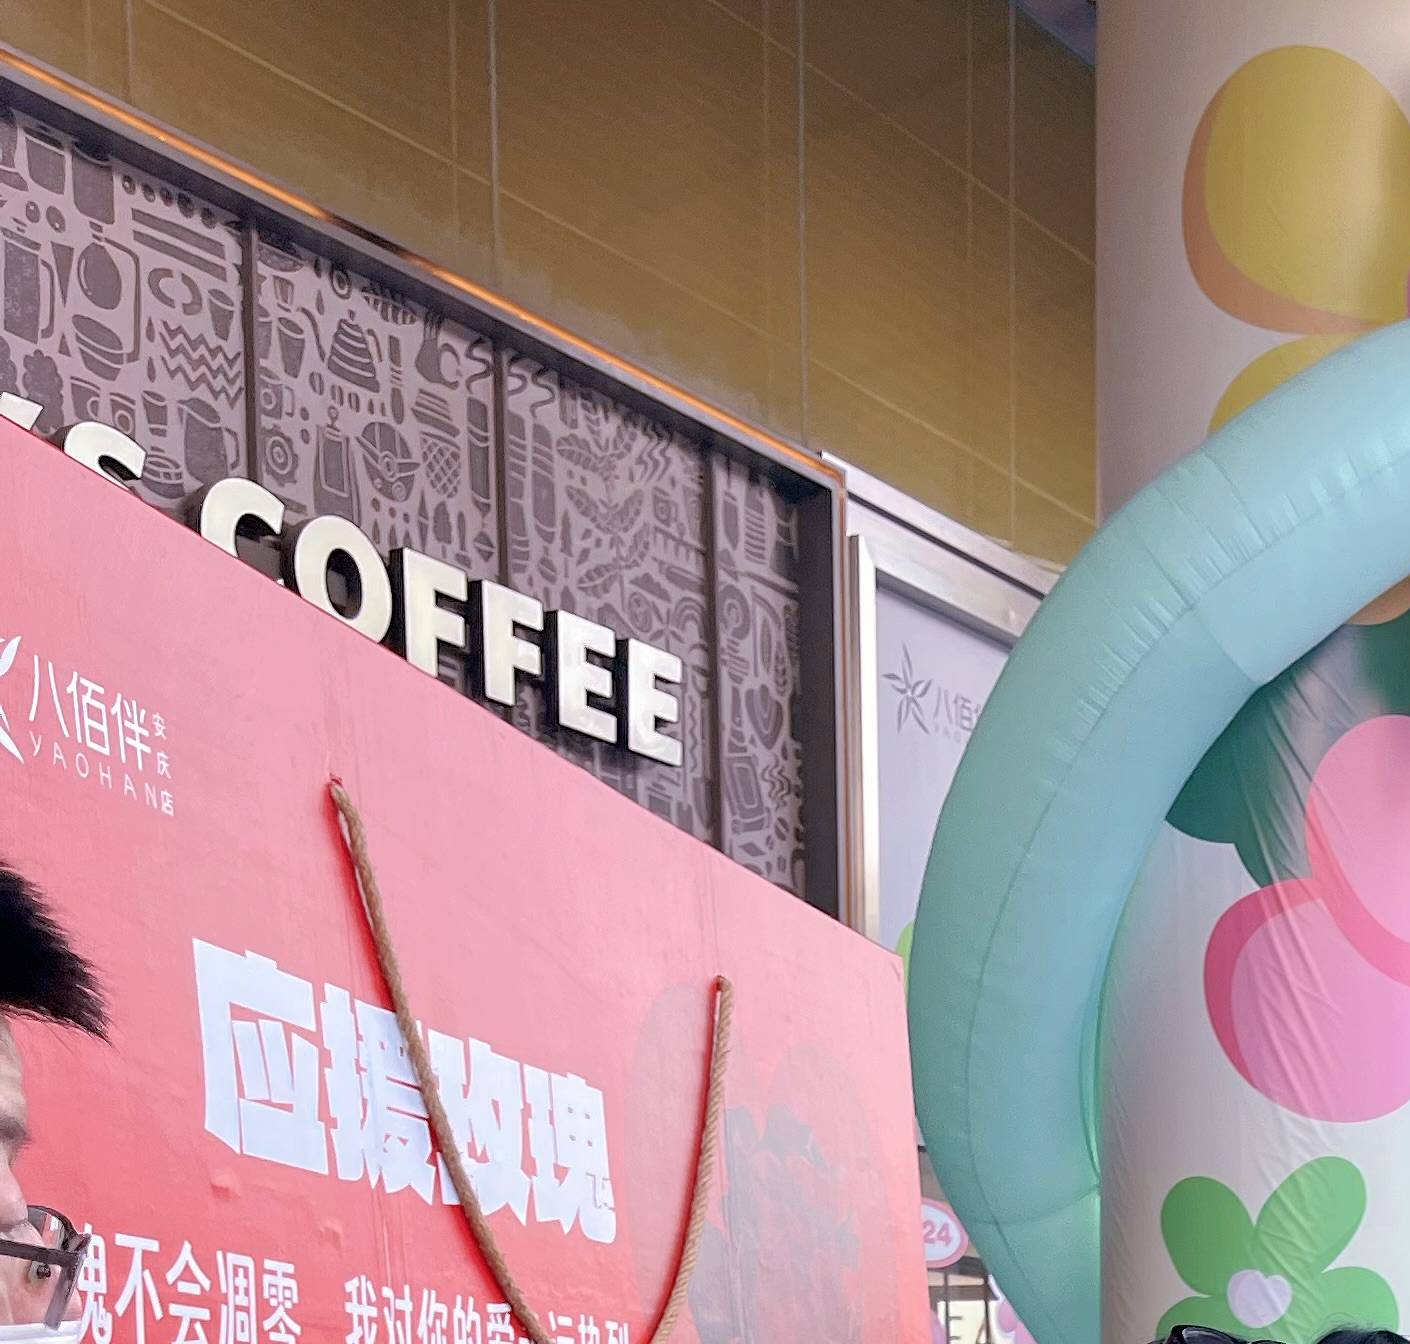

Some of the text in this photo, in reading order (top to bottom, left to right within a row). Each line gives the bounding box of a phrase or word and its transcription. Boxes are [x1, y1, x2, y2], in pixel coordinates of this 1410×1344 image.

[200, 477, 684, 768] COFFEE
[29, 653, 152, 772] 八佰伴
[151, 711, 175, 817] 安庆店
[933, 686, 982, 733] 八佰
[28, 730, 158, 809] YAOHAN
[192, 937, 617, 1245] 应援玫瑰
